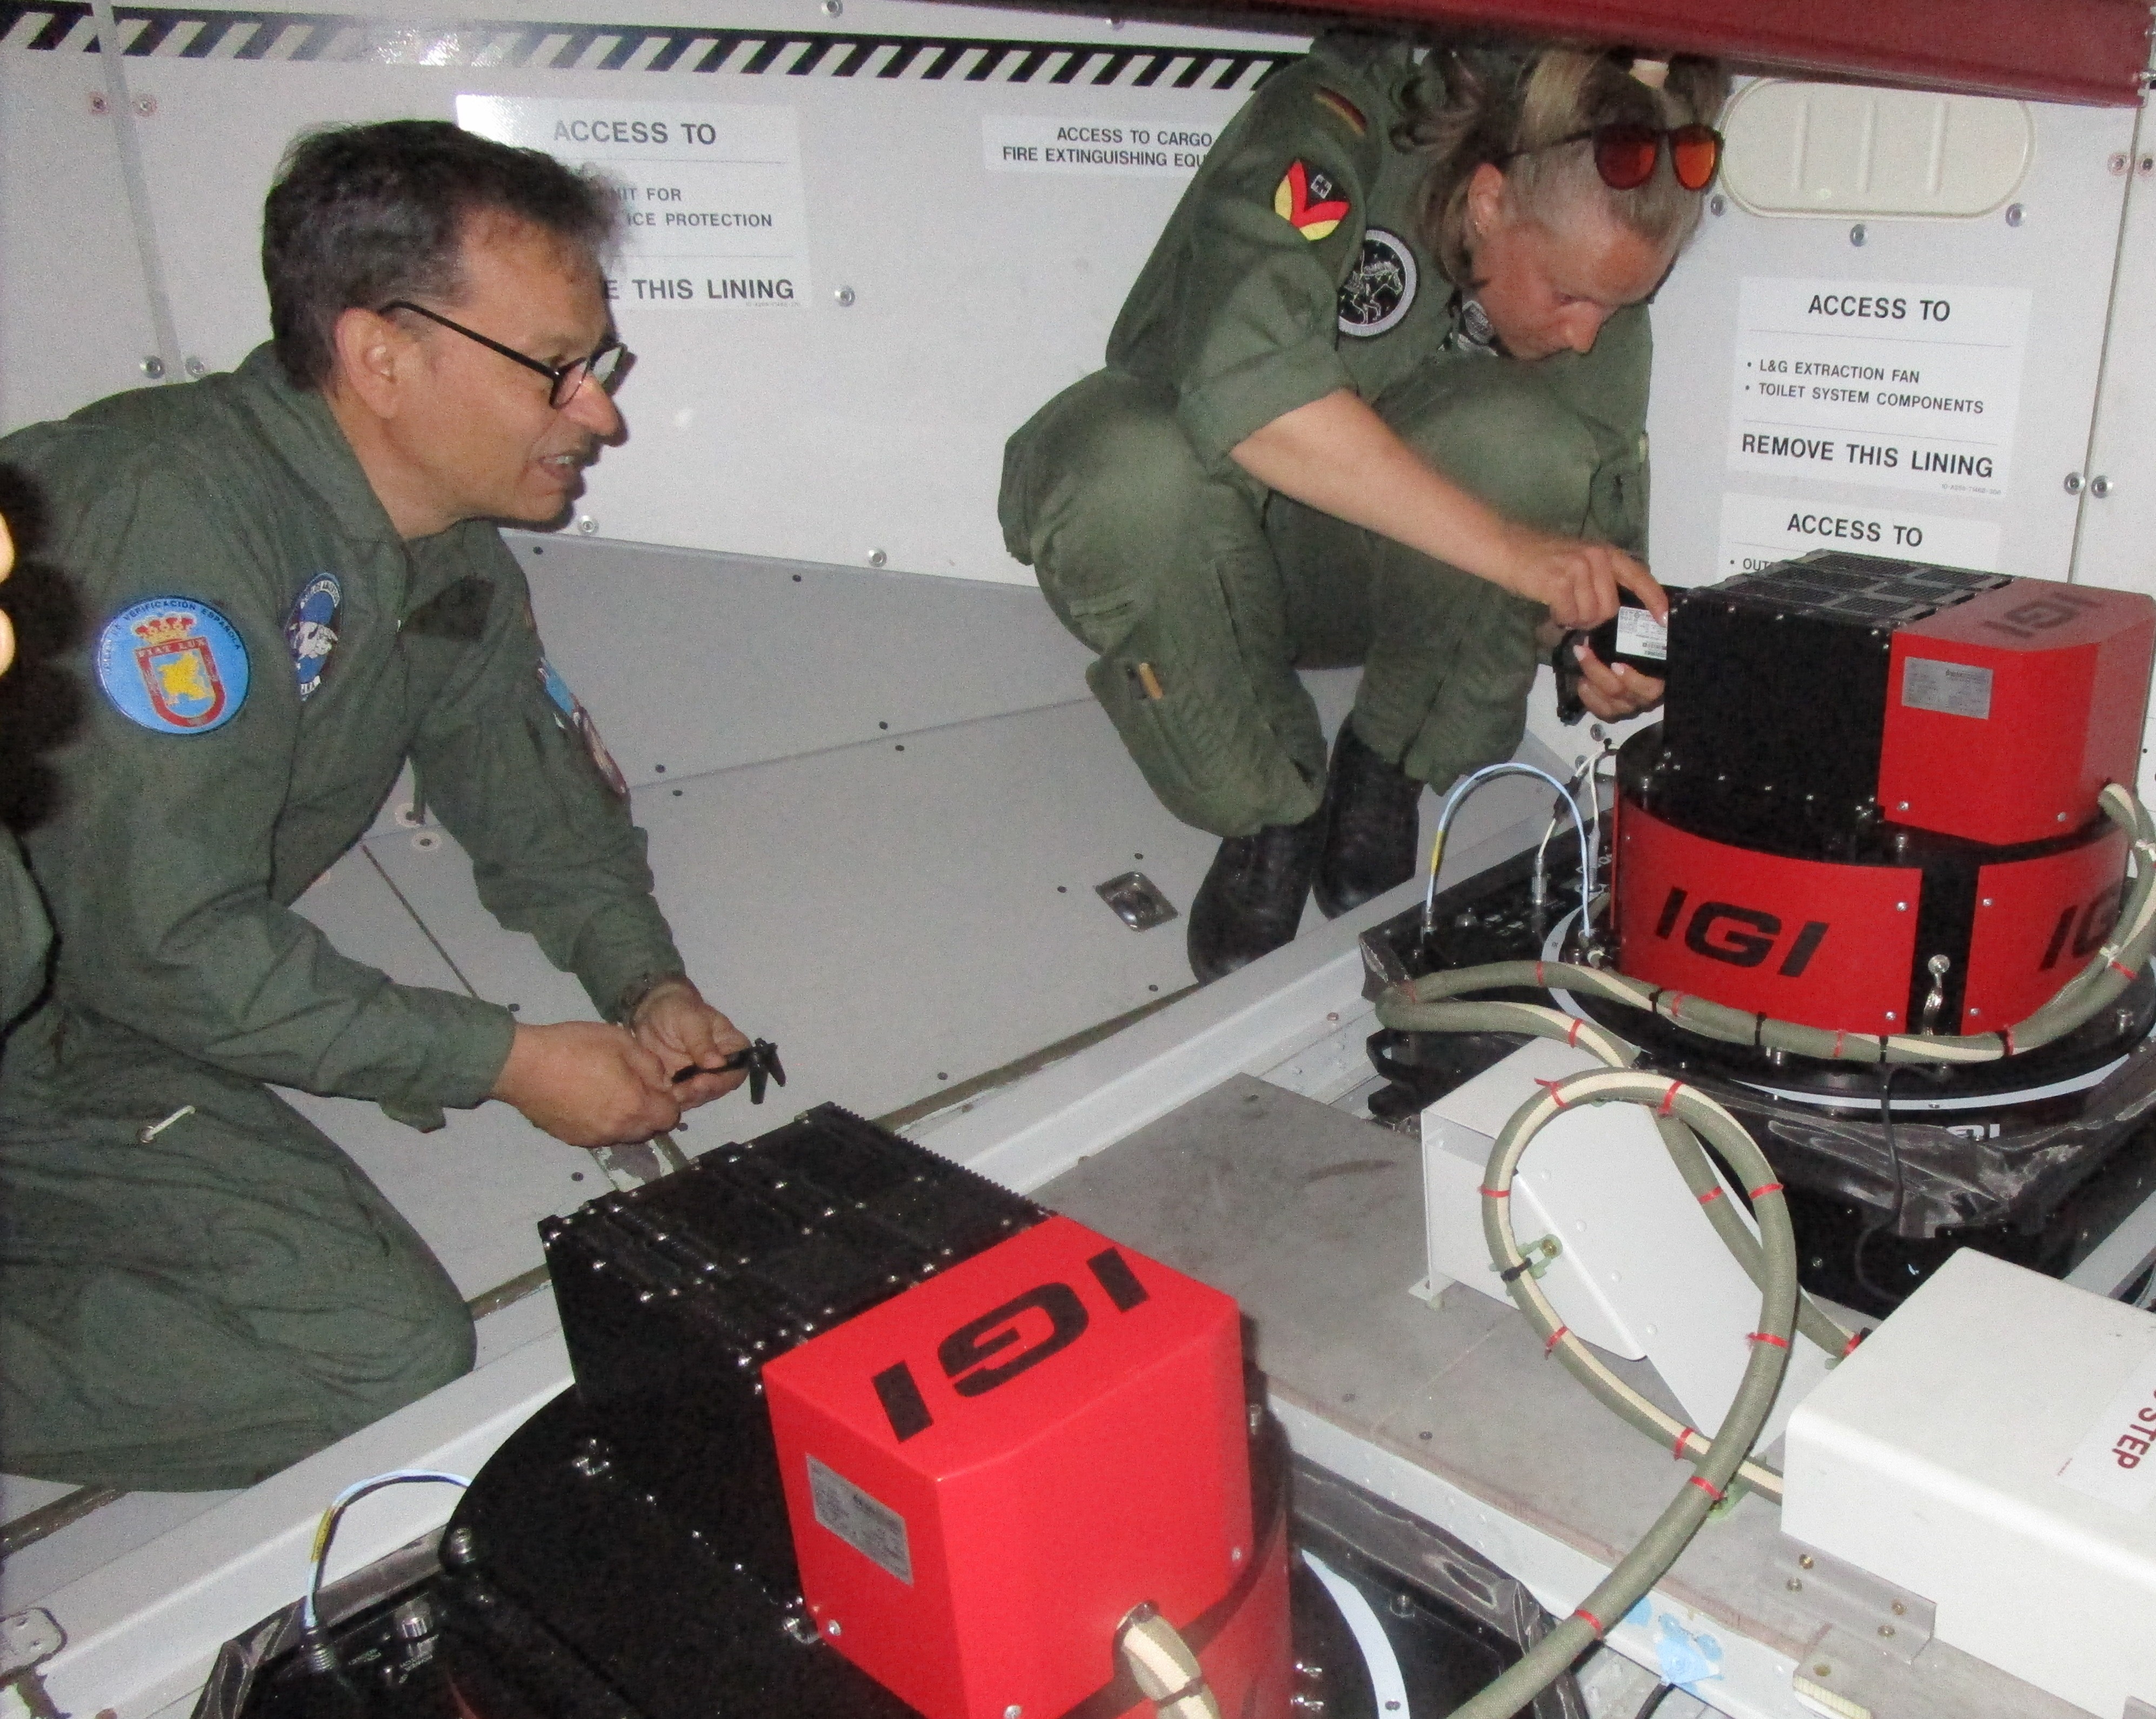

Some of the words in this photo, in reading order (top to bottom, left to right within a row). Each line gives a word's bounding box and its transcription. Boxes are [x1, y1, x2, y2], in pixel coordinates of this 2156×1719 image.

[554, 120, 668, 144] ACCESS
[681, 123, 716, 145] TO
[1057, 127, 1123, 143] ACCESS
[1131, 130, 1150, 144] TO
[1158, 131, 1212, 147] CARGO
[1003, 146, 1038, 161] FIRE
[1046, 148, 1167, 166] EXTINGUISHING
[646, 188, 682, 202] FOR
[665, 212, 772, 228] PROTECTION
[631, 279, 693, 299] THIS
[707, 278, 795, 299] LINING
[1808, 295, 1907, 319] ACCESS
[1920, 299, 1951, 322] TO
[1759, 359, 1788, 373] L&G
[1794, 362, 1885, 381] EXTRACTION
[1892, 369, 1920, 384] FAN
[1758, 382, 1806, 399] TOILET
[1812, 387, 1870, 404] SYSTEM
[1877, 392, 1984, 414] COMPONENTS
[1742, 433, 1835, 461] REMOVE
[1846, 444, 1899, 468] THIS
[1911, 450, 1994, 478] LINING
[1787, 513, 1881, 542] ACCESS
[1893, 525, 1923, 547] TO
[1656, 886, 1830, 978] IGI
[871, 1247, 1151, 1443] IGI
